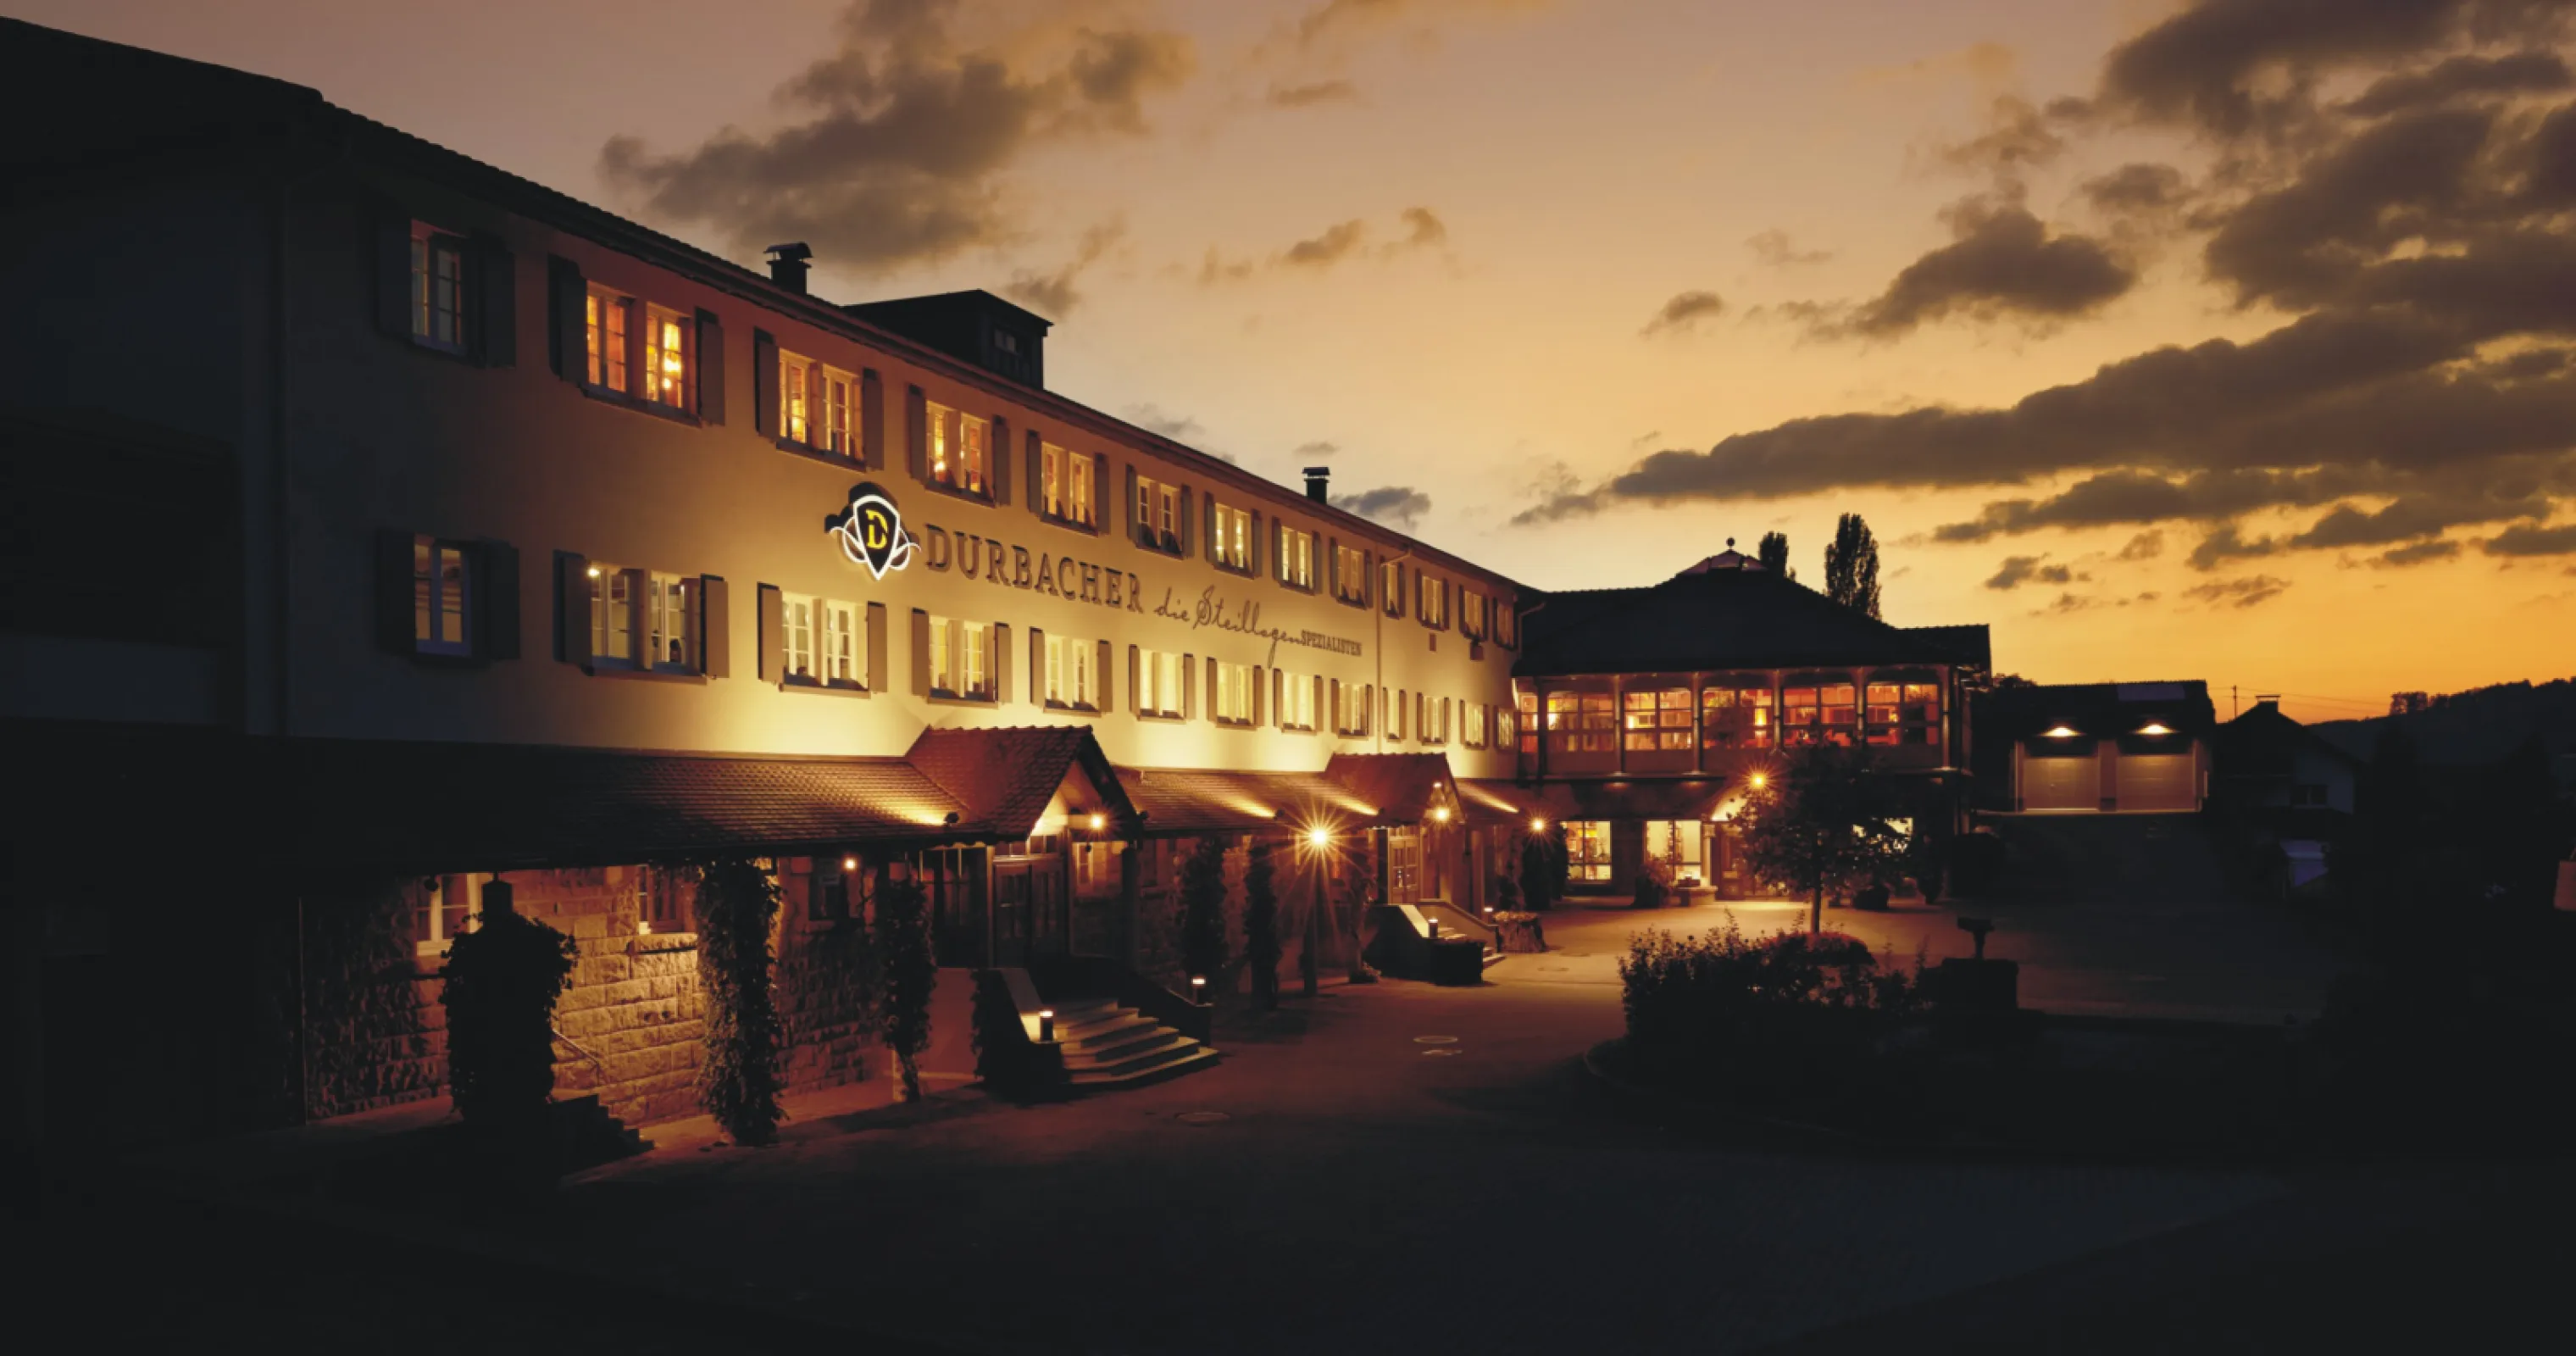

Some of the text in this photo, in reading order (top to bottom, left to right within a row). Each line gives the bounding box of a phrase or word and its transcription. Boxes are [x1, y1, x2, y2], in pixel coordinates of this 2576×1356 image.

[865, 508, 889, 549] D
[924, 522, 1144, 614] DURBACHER
[1153, 586, 1190, 622] die
